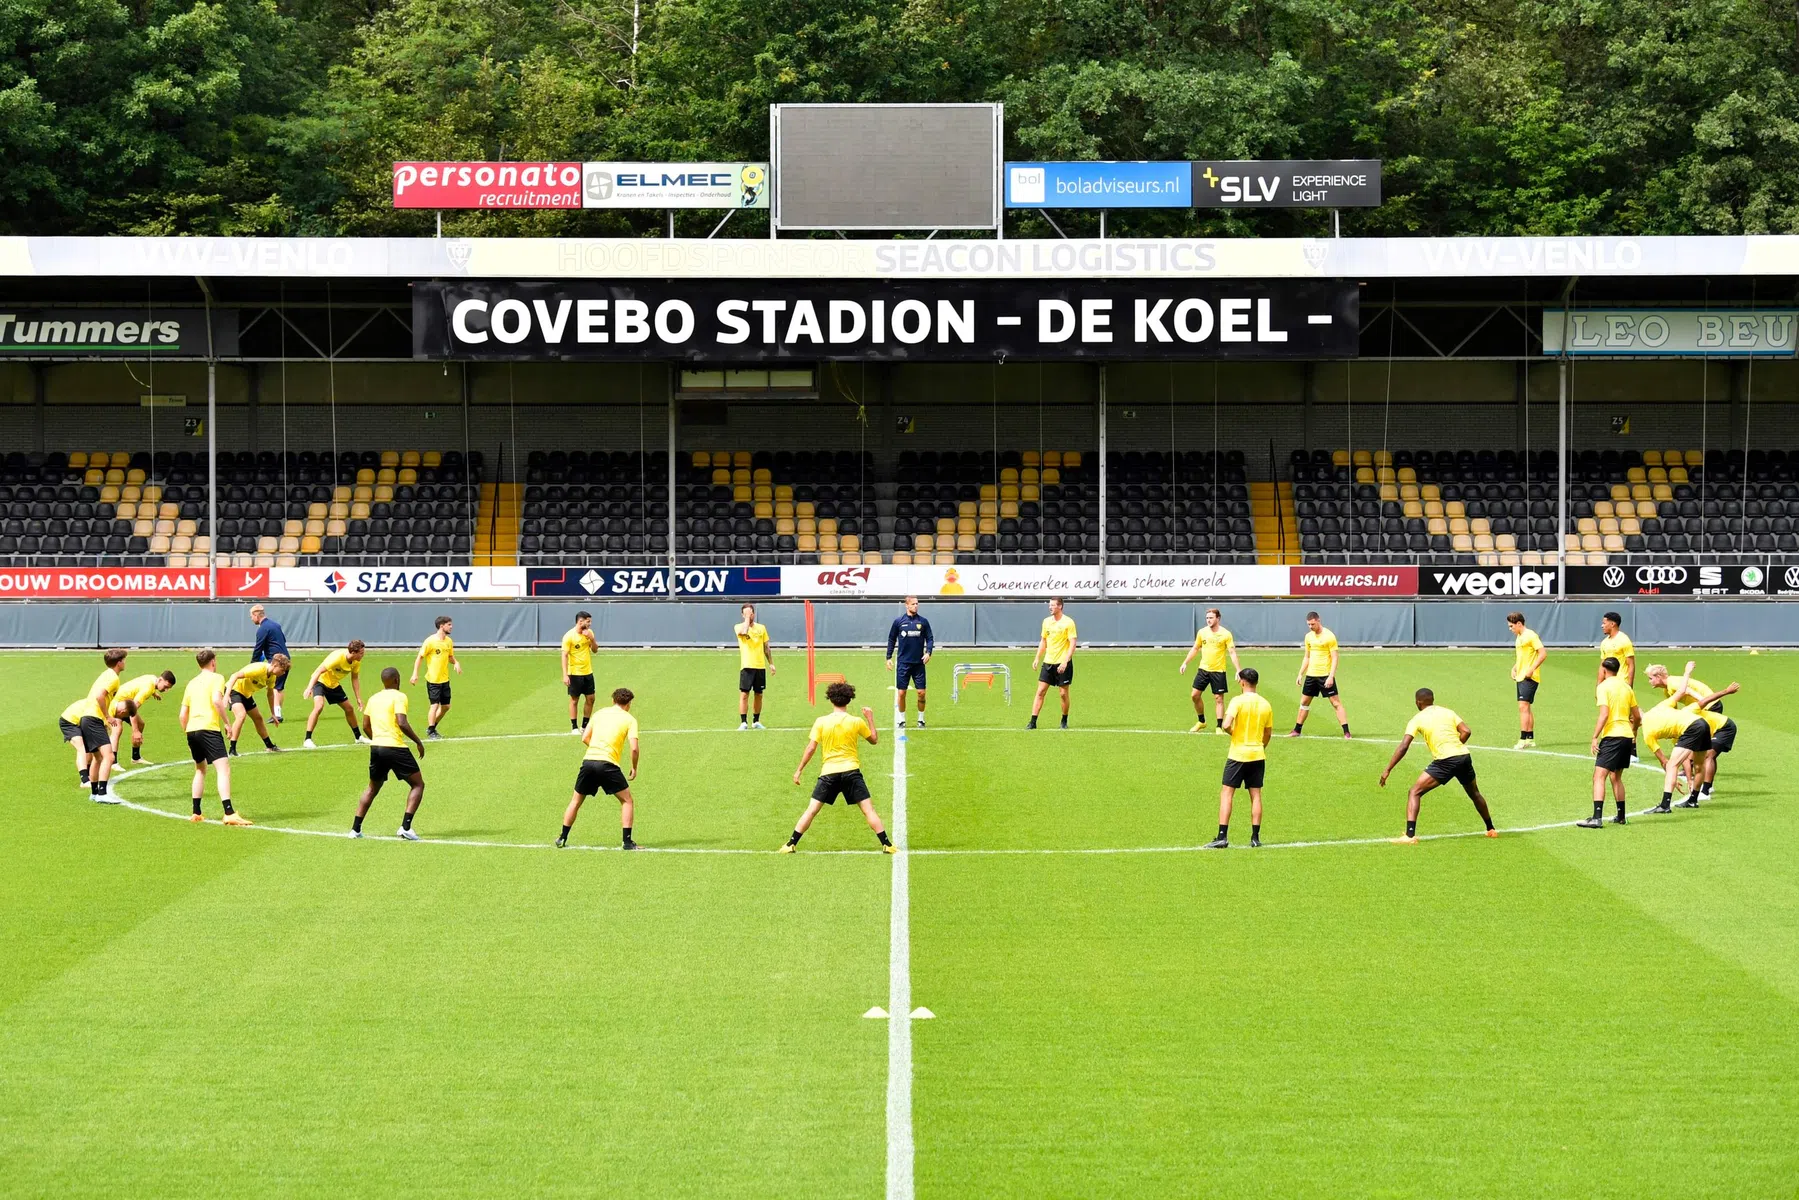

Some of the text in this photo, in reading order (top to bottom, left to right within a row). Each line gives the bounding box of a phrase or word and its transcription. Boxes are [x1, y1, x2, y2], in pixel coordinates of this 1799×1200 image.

[394, 163, 580, 195] personato
[616, 173, 732, 187] ELMEC
[1018, 173, 1041, 185] bol
[1056, 177, 1179, 194] boladviseurs.nl
[1220, 176, 1281, 202] SLV
[1292, 175, 1367, 186] EXPERIENCE
[479, 190, 580, 206] recruitment
[1292, 191, 1328, 202] LIGHT
[136, 240, 354, 272] VVV-VENLO
[557, 242, 866, 273] HOOFDSPONSOR
[875, 242, 1216, 273] SEACON LOGISTICS
[1421, 240, 1642, 271] VVV-VENLO
[0, 314, 180, 343] Tummers
[452, 299, 695, 344] COVEBO
[716, 299, 975, 344] STADION
[1038, 299, 1113, 343] DE
[1135, 298, 1288, 343] KOEL
[1571, 315, 1799, 348] LEO BEU
[0, 574, 211, 591] OUW DROOMBAAN
[356, 572, 472, 592] SEACON
[611, 570, 728, 593] SEACON
[977, 571, 1227, 592] Samenwerken aan een schone wereld
[1299, 572, 1399, 589] www.acs.nu
[1433, 567, 1556, 595] wealer
